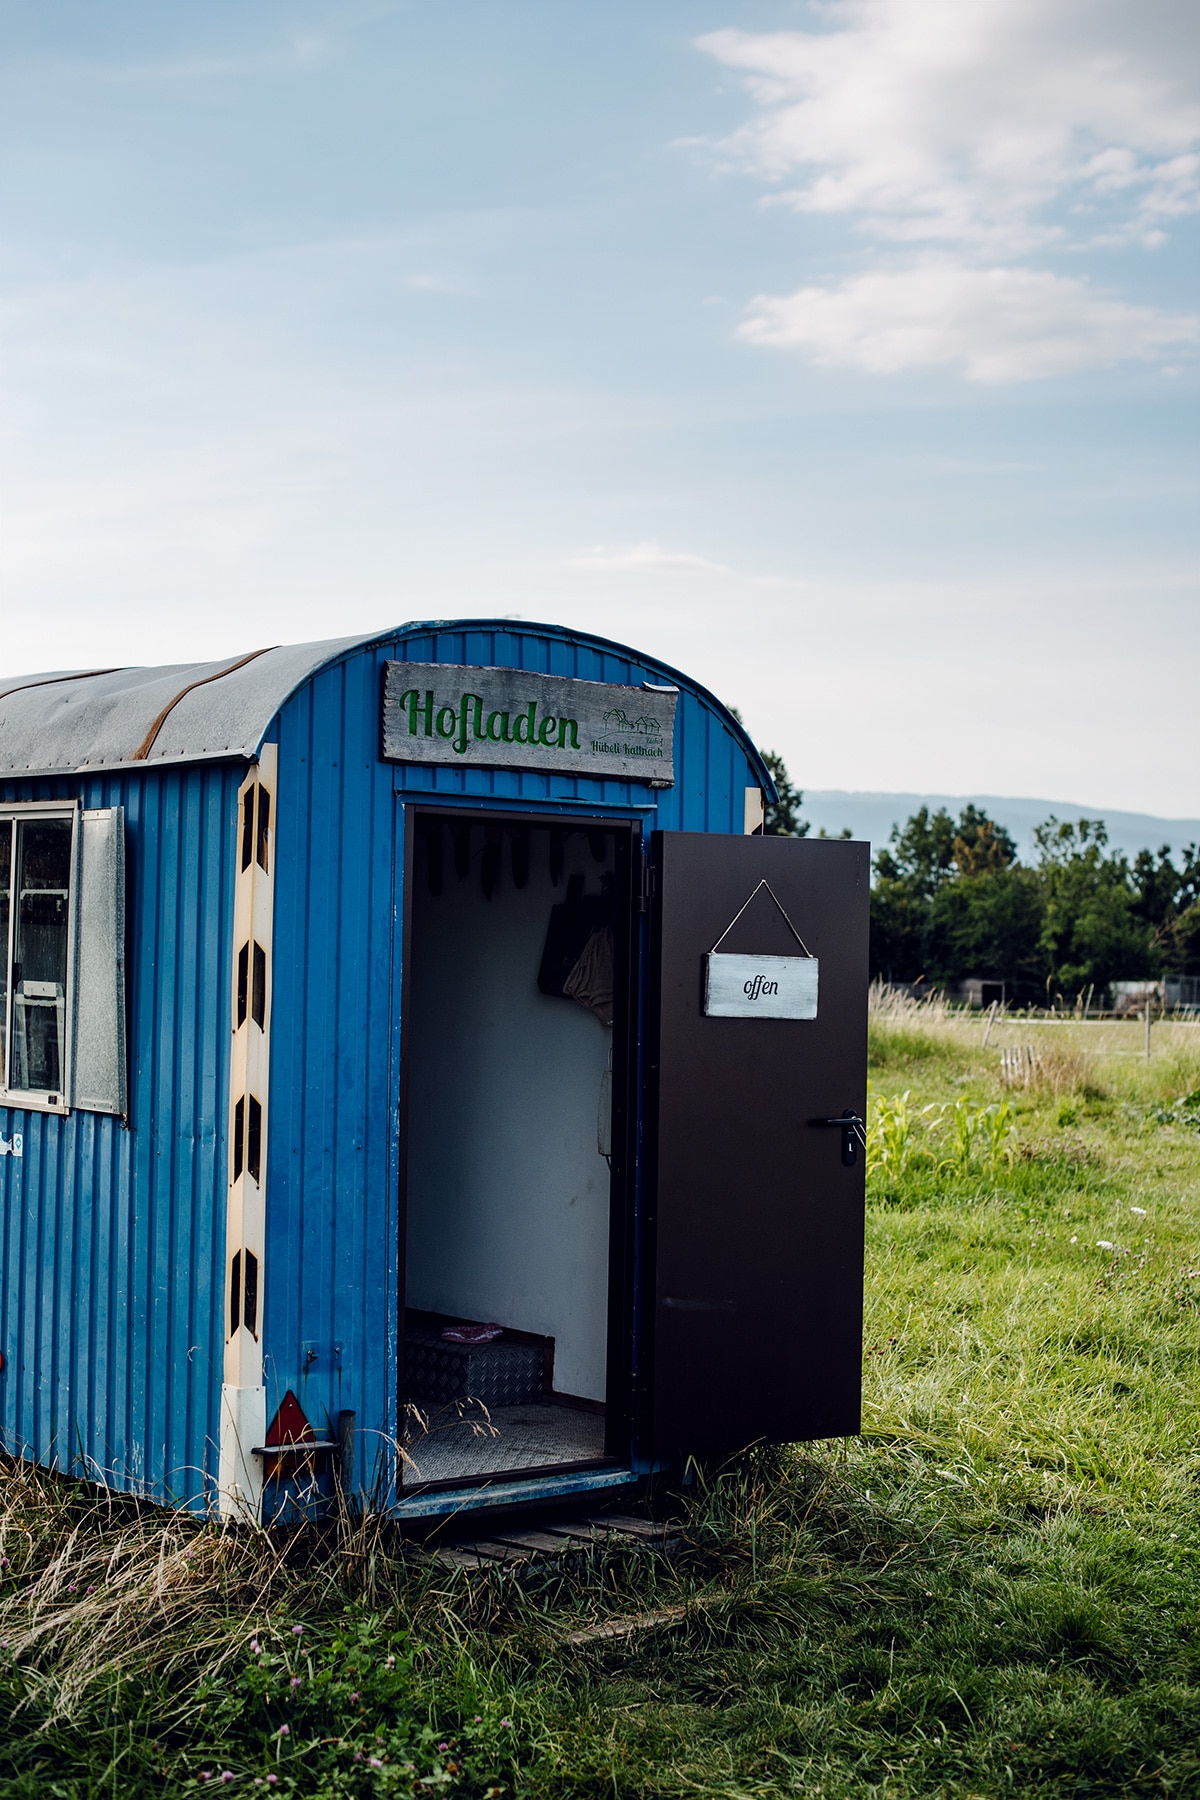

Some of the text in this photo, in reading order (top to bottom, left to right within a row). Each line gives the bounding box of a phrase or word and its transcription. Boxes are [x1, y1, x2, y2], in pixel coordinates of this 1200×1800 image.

[400, 689, 581, 754] Hofladen
[592, 740, 620, 753] Hübeli
[743, 974, 779, 1001] offen
